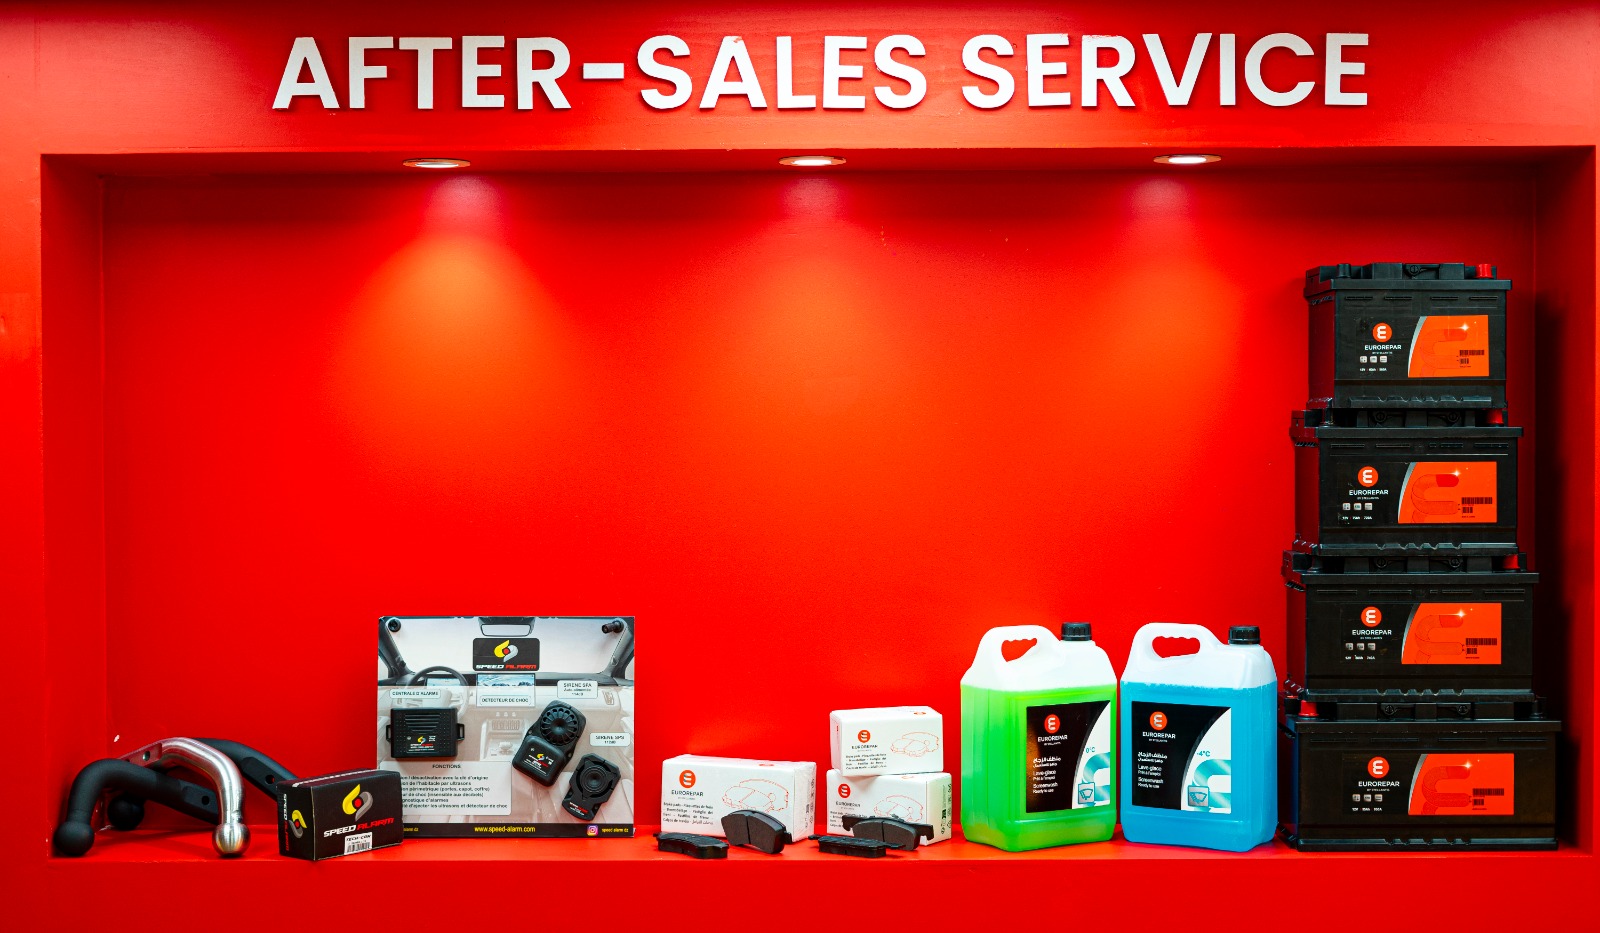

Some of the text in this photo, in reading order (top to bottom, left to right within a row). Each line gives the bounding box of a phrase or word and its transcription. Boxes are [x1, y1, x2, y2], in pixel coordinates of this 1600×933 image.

[272, 32, 1369, 110] AFTER-SALES SERVICE
[323, 818, 394, 838] SPEED ALARM
[474, 825, 536, 833] www.speed-alarm.com
